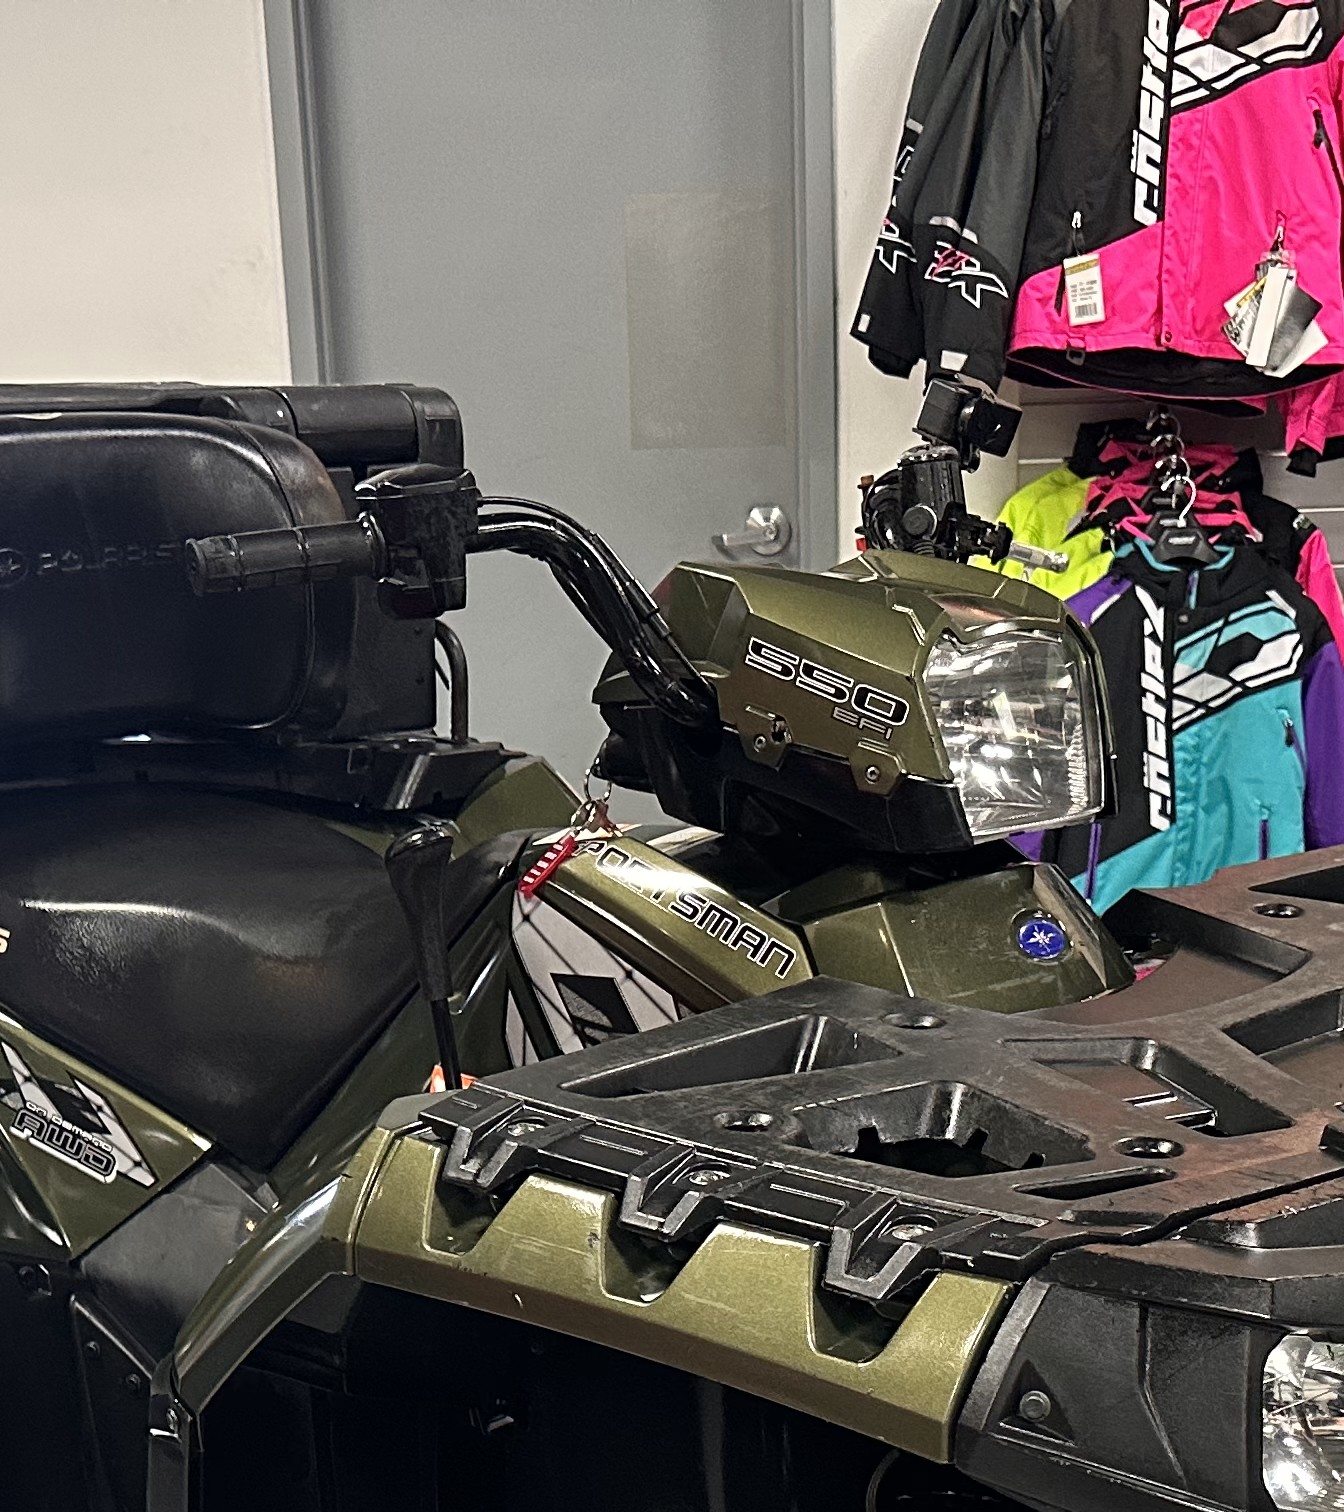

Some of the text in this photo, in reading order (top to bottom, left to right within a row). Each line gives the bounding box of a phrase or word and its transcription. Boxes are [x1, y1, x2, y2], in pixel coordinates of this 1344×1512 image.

[745, 636, 910, 726] 550
[832, 706, 893, 740] EFI
[14, 1109, 117, 1178] AWD
